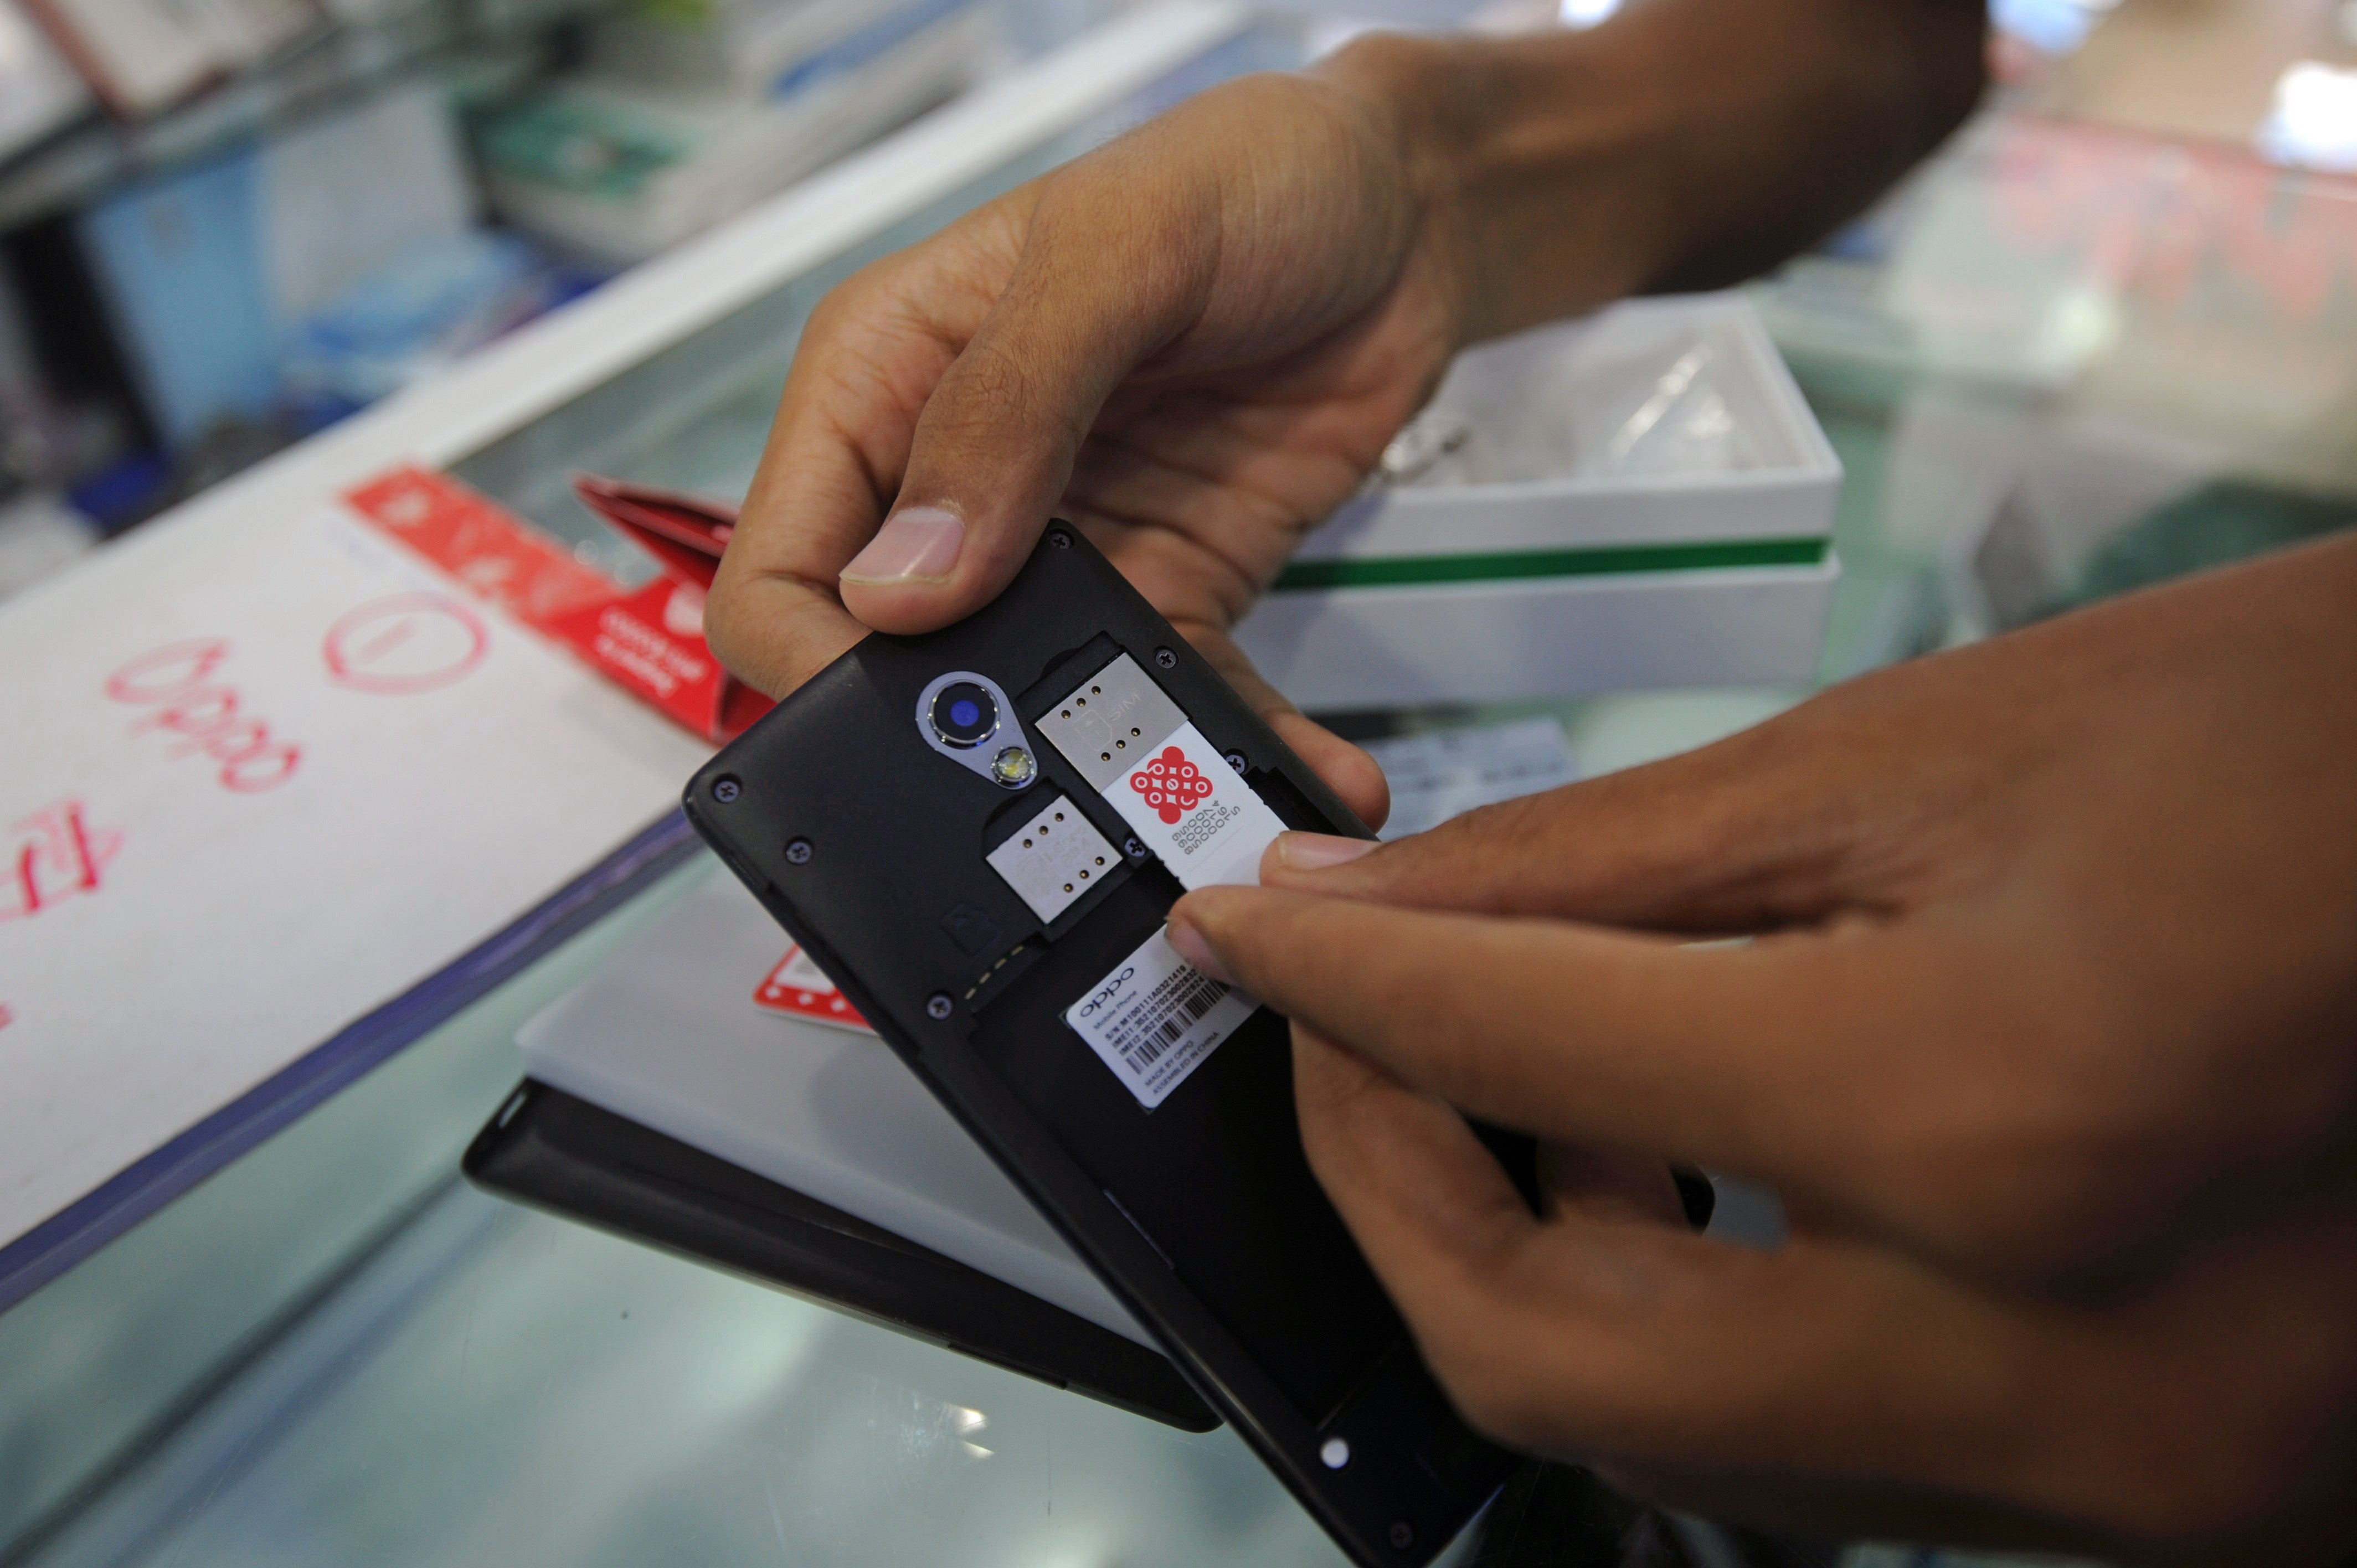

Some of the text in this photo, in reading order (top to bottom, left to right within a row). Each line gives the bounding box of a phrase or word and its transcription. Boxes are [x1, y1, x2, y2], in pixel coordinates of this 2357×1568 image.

[1080, 968, 1134, 1017] oppo
[1116, 991, 1137, 1009] Phone
[1145, 1066, 1165, 1087] MADE
[1153, 1058, 1191, 1095] ASSEMBLED
[1197, 1032, 1219, 1052] CHINA
